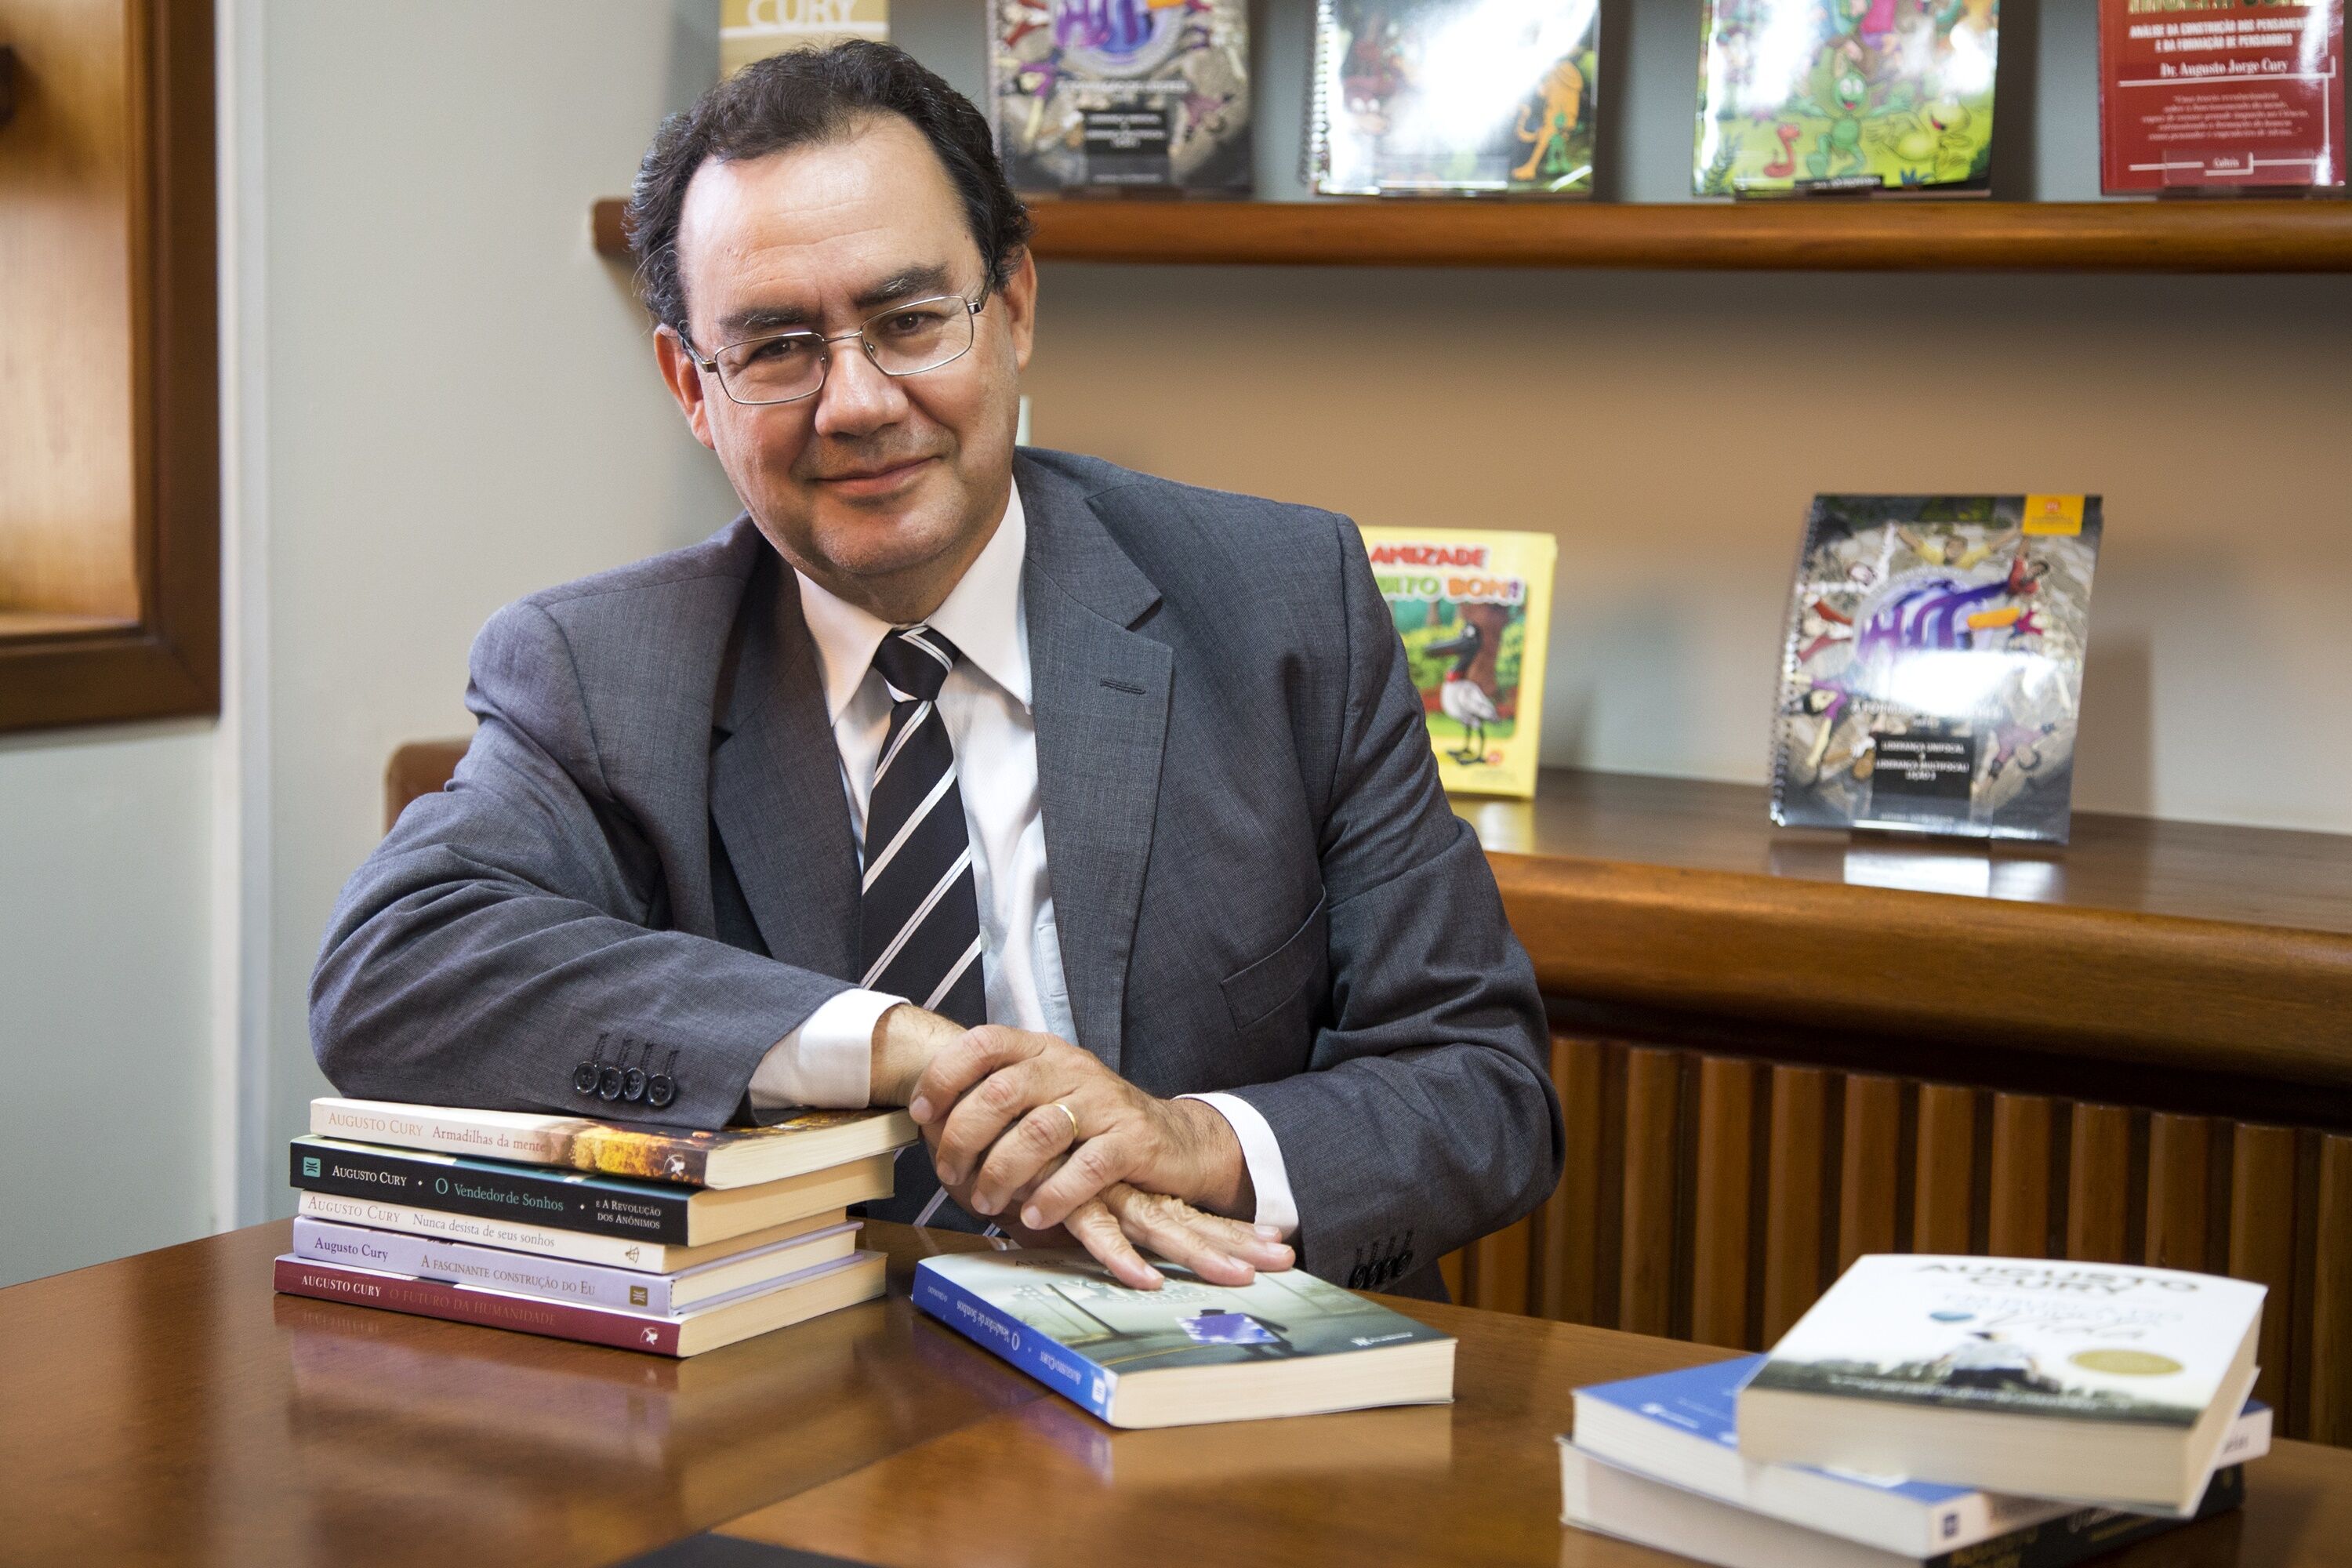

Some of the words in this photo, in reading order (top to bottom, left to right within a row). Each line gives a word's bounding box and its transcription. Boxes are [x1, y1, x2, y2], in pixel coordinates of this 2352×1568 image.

[747, 0, 855, 26] CURY
[2160, 63, 2177, 77] Dr.
[2180, 62, 2226, 77] Augusto
[2228, 59, 2259, 74] Jorge
[2261, 57, 2288, 73] Cury
[1371, 546, 1484, 568] AMIZADE
[328, 1112, 385, 1131] AUGUSTO
[390, 1120, 423, 1137] CURY
[433, 1125, 493, 1145] Armadilhas
[497, 1134, 510, 1147] da
[513, 1140, 546, 1152] mente
[332, 1165, 377, 1182] AUGUSTO
[379, 1172, 407, 1186] CURY
[435, 1178, 448, 1195] O
[454, 1183, 506, 1202] Vendedor
[506, 1191, 519, 1204] de
[522, 1195, 564, 1211] Sonhos
[308, 1196, 361, 1216] AUGUSTO
[367, 1206, 400, 1223] CURY
[597, 1212, 613, 1222] DOS
[602, 1200, 609, 1210] A
[612, 1200, 661, 1217] REVOLUÇÃO
[413, 1214, 445, 1230] Nunca
[448, 1218, 479, 1236] desista
[483, 1222, 495, 1237] de
[498, 1229, 517, 1242] seus
[521, 1232, 555, 1247] sonhos
[314, 1237, 358, 1254] Augusto
[361, 1244, 388, 1262] Cury
[421, 1254, 430, 1268] A
[434, 1259, 489, 1278] FASCINANTE
[493, 1269, 558, 1290] CONSTRUÇÃO
[562, 1281, 576, 1293] DO
[1915, 1263, 2201, 1292] AUGUSTO
[302, 1276, 350, 1292] AUGUSTO
[353, 1283, 382, 1297] CURY
[390, 1290, 399, 1299] O
[404, 1290, 449, 1307] FUTURO
[454, 1298, 469, 1312] DA
[474, 1301, 556, 1326] HUMANIDADE
[956, 1300, 978, 1323] Sonhos
[1011, 1333, 1020, 1351] O
